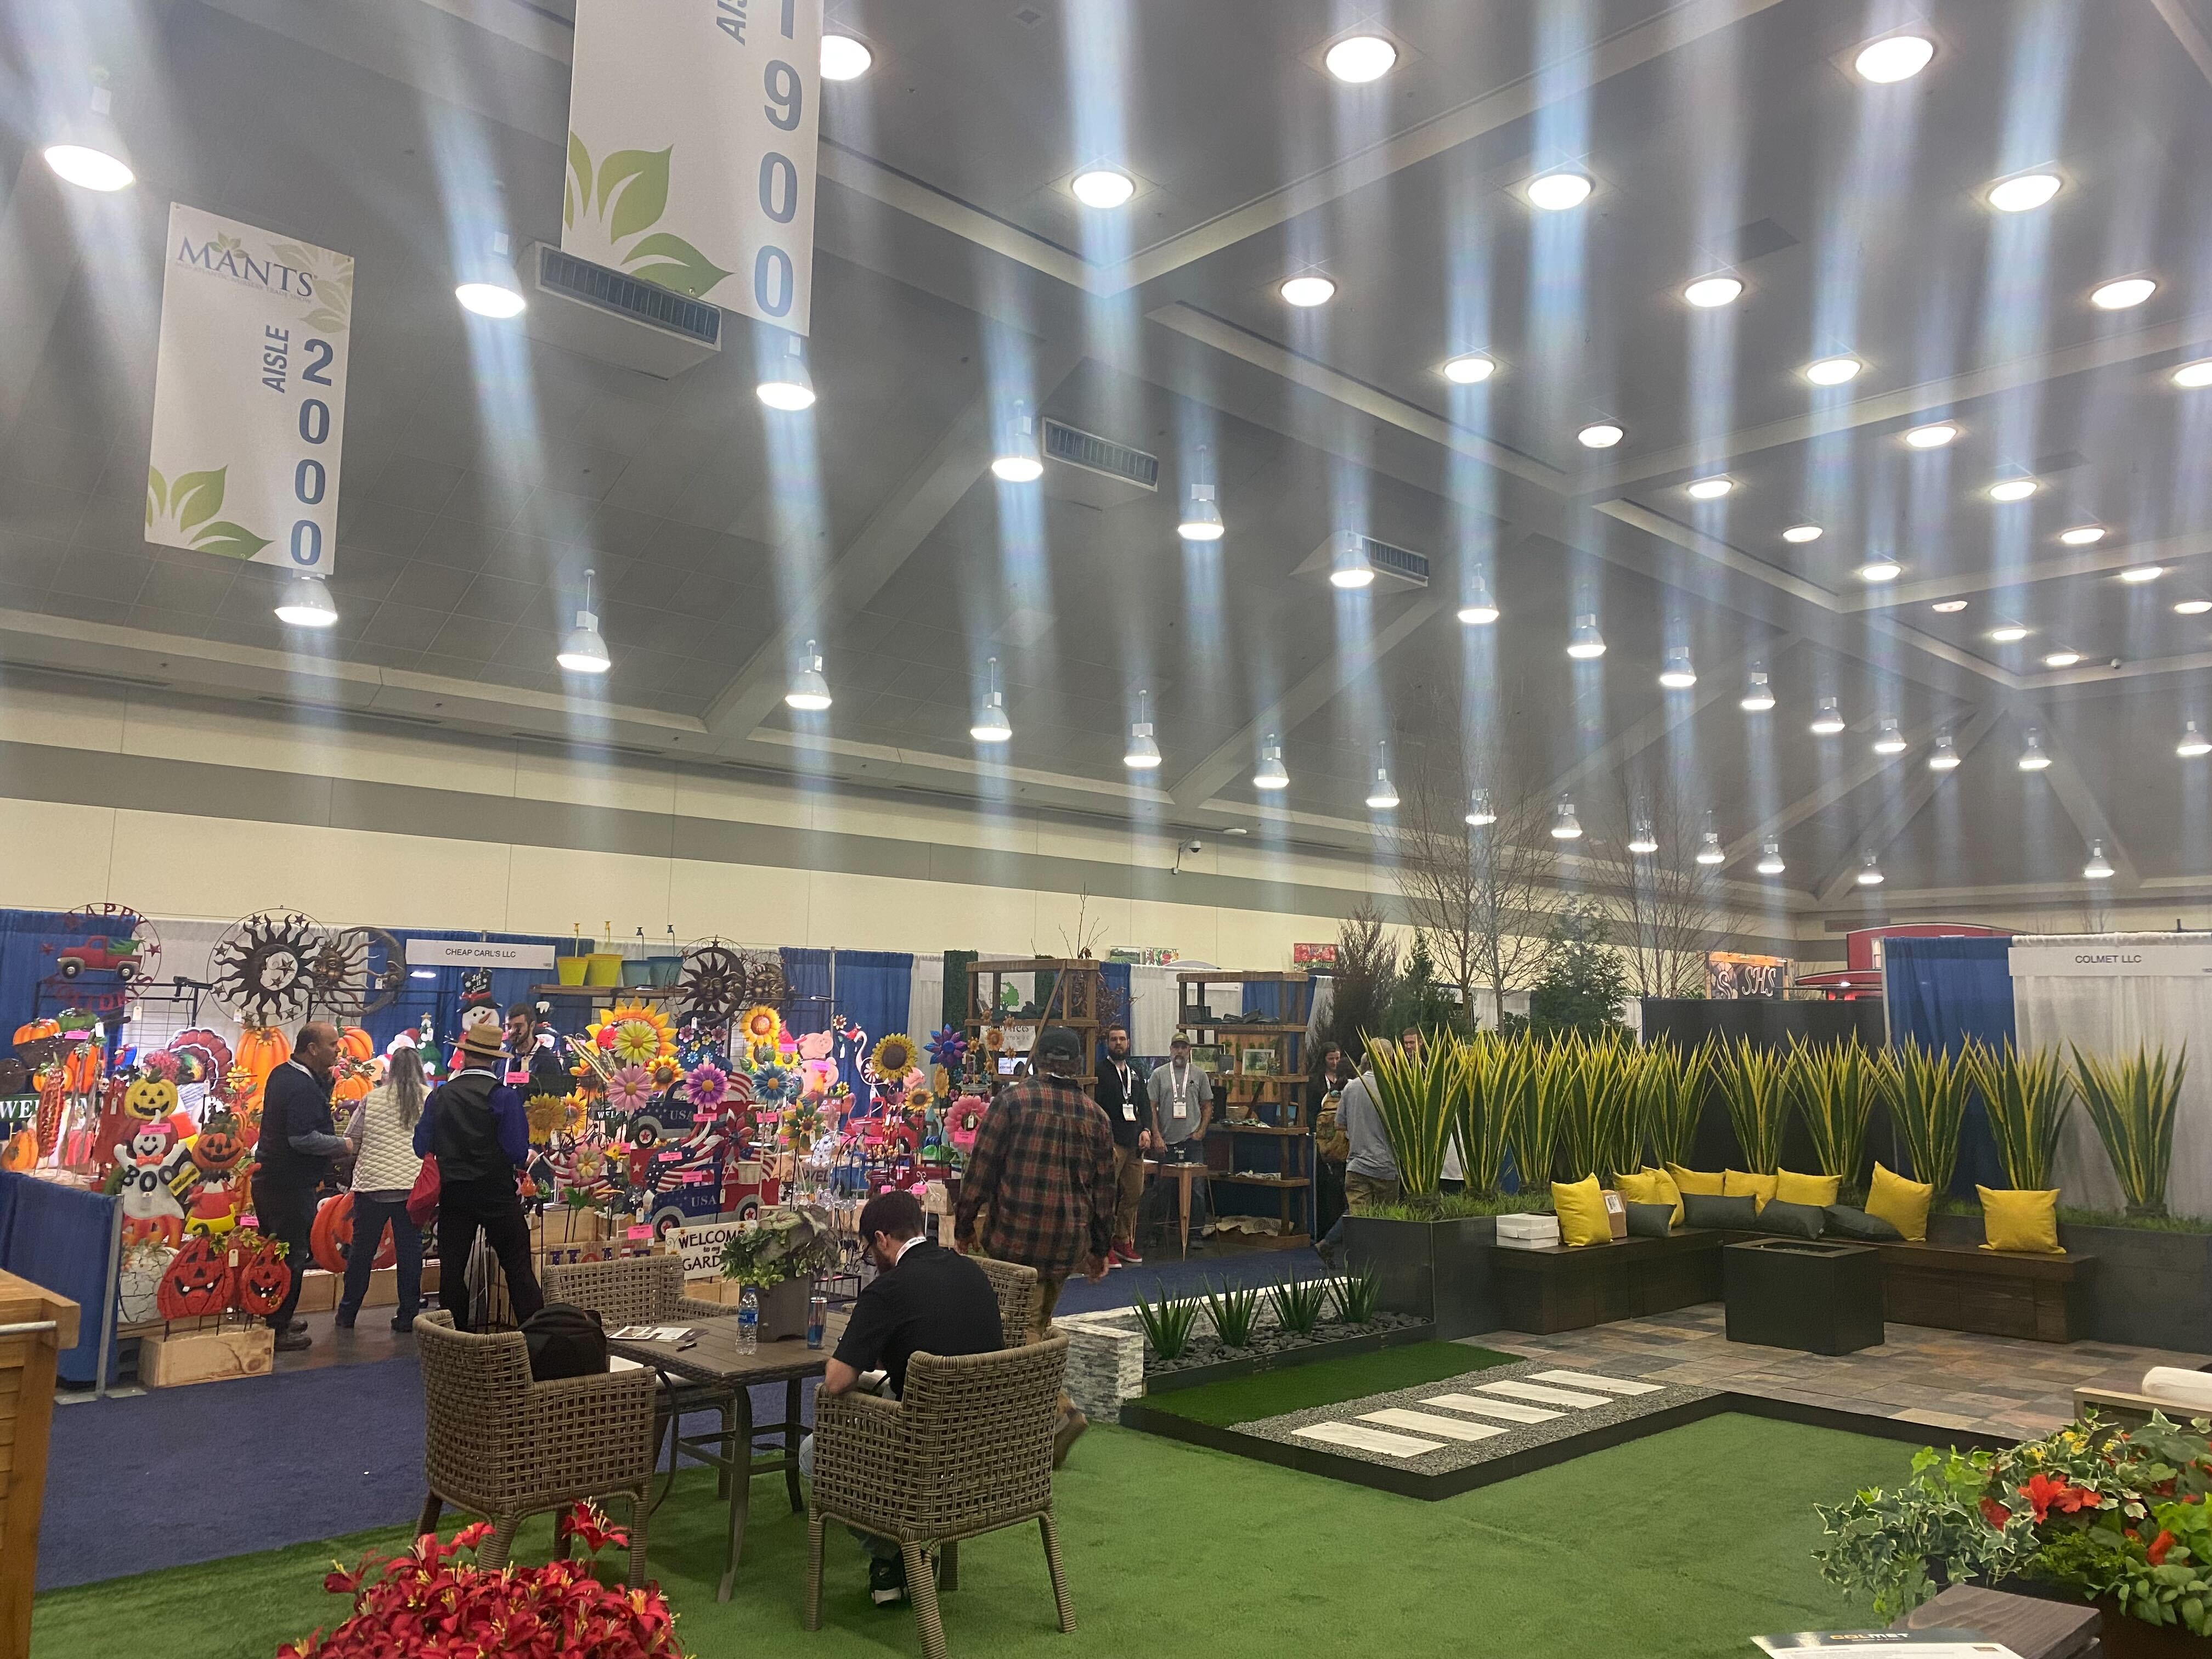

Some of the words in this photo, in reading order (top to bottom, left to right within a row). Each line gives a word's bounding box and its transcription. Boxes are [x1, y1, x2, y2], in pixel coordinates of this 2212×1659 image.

[177, 236, 313, 297] MANTS
[262, 325, 289, 393] AISLE
[290, 338, 334, 566] 2000
[474, 950, 500, 958] CARL'S
[2075, 955, 2119, 963] COLMET
[2121, 955, 2142, 963] LLC
[122, 1164, 179, 1192] BOO
[691, 1195, 716, 1207] USA
